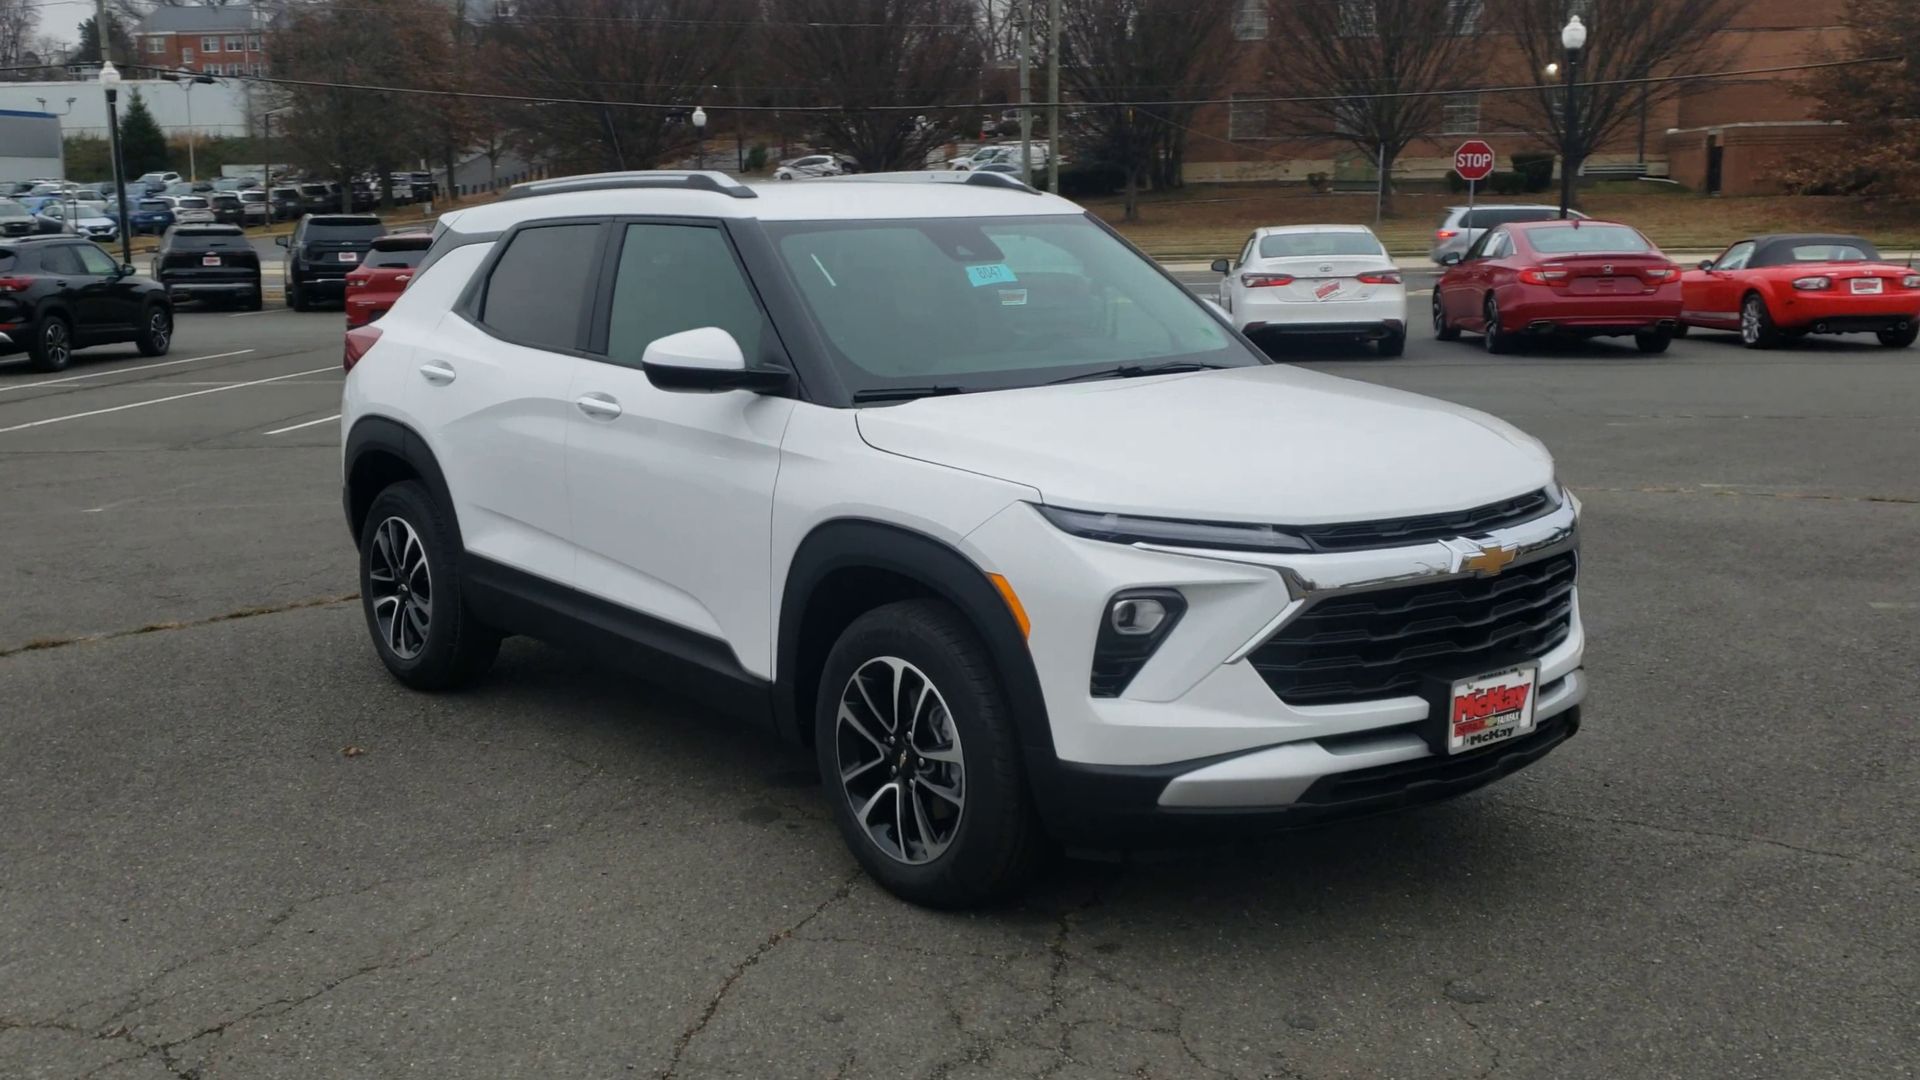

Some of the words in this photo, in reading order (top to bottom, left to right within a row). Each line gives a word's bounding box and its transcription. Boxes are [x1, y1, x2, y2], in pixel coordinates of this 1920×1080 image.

[1457, 153, 1491, 168] STOP
[1453, 683, 1531, 723] McKay
[1470, 727, 1515, 745] McKay
